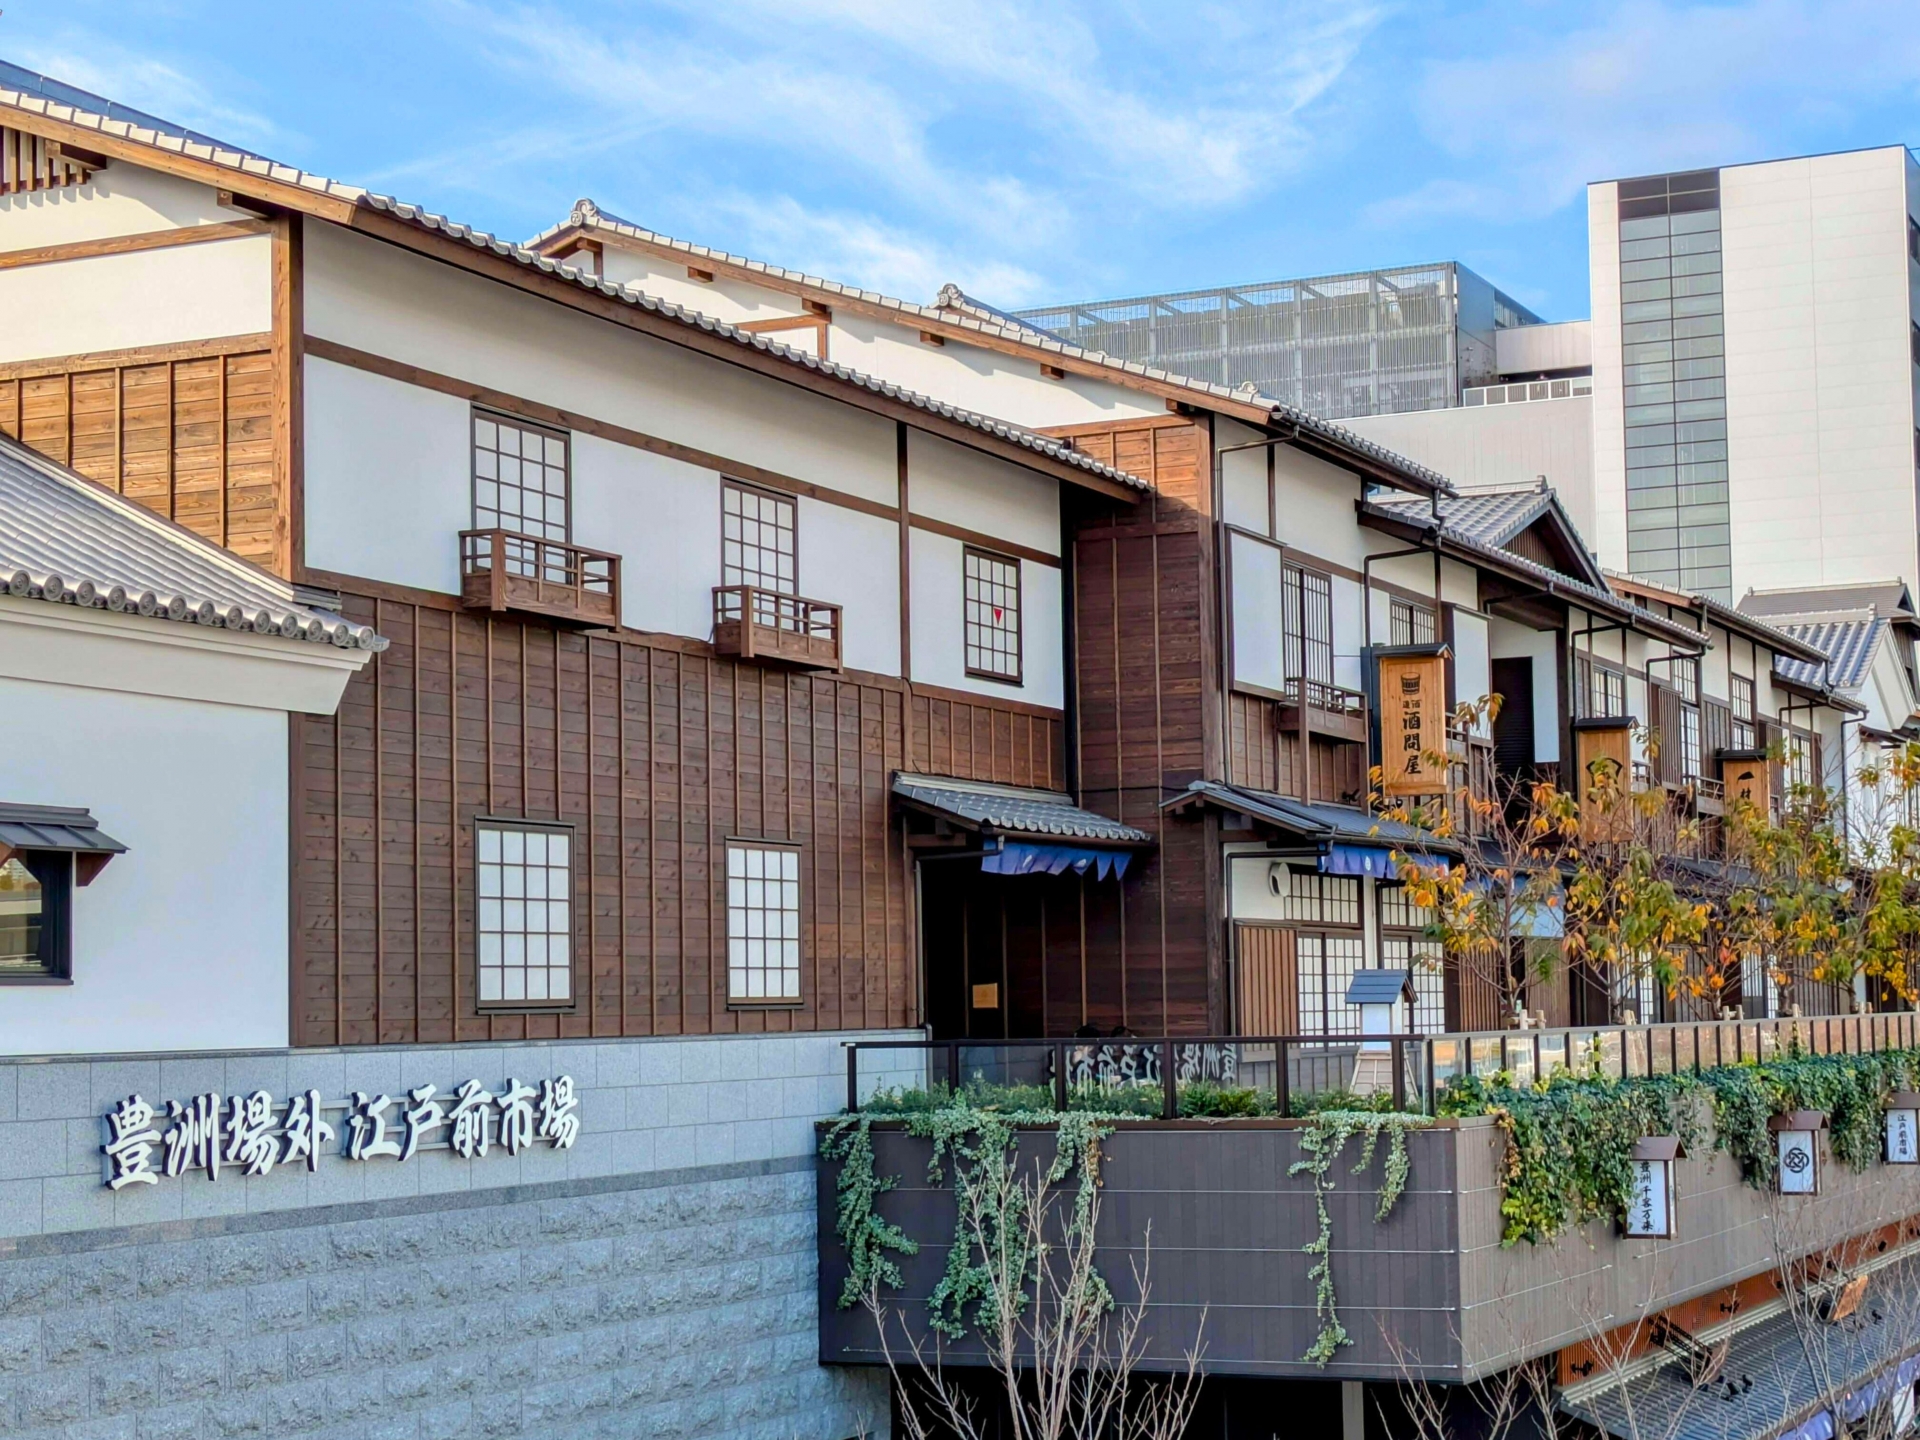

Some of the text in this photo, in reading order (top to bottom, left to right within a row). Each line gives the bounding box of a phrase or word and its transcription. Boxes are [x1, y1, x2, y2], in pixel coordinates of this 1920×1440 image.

[1402, 711, 1422, 775] 酒問屋
[102, 1075, 578, 1191] 豊洲場外江戸前市場
